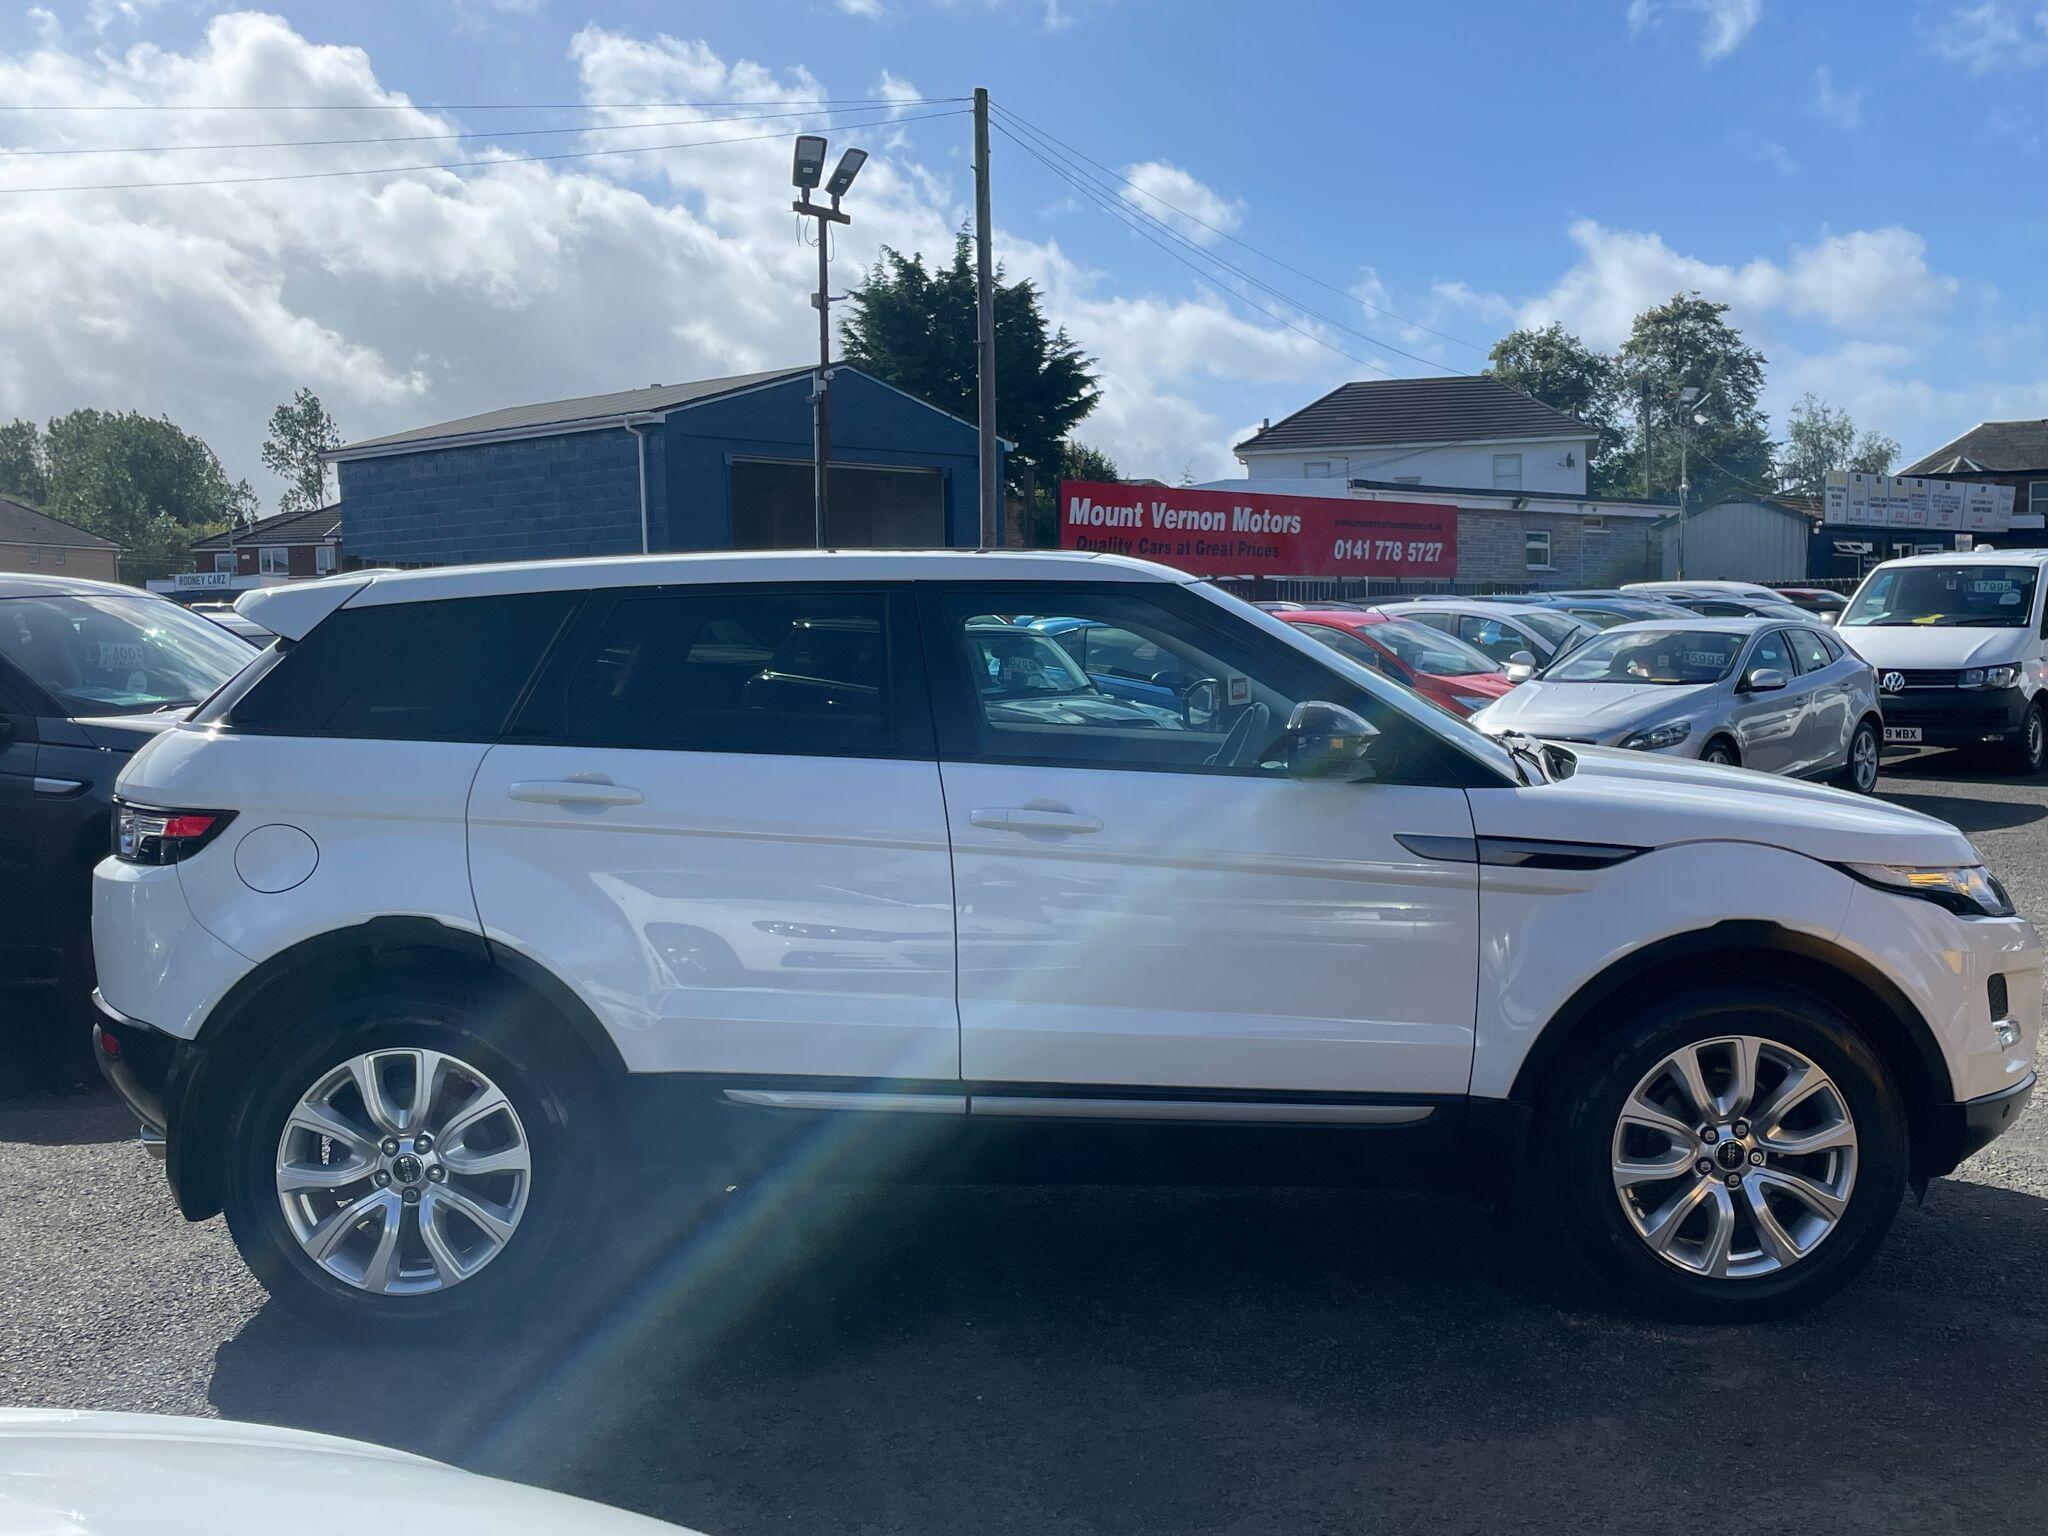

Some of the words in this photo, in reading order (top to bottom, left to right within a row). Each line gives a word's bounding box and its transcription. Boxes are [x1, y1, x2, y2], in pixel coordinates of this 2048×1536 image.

[1068, 497, 1144, 528] Mount
[1151, 502, 1226, 531] Vernon
[1232, 506, 1302, 534] Motors
[1076, 535, 1133, 553] Quality
[1138, 538, 1172, 555] Cars
[1176, 541, 1191, 555] at
[1196, 540, 1233, 556] Great
[1238, 541, 1280, 558] Prices
[1334, 539, 1371, 560] 0141
[1375, 540, 1403, 561] 778
[1408, 542, 1443, 562] 5727
[179, 575, 206, 586] ROONEY
[207, 574, 227, 585] CARZ
[1895, 729, 1917, 739] WBX
